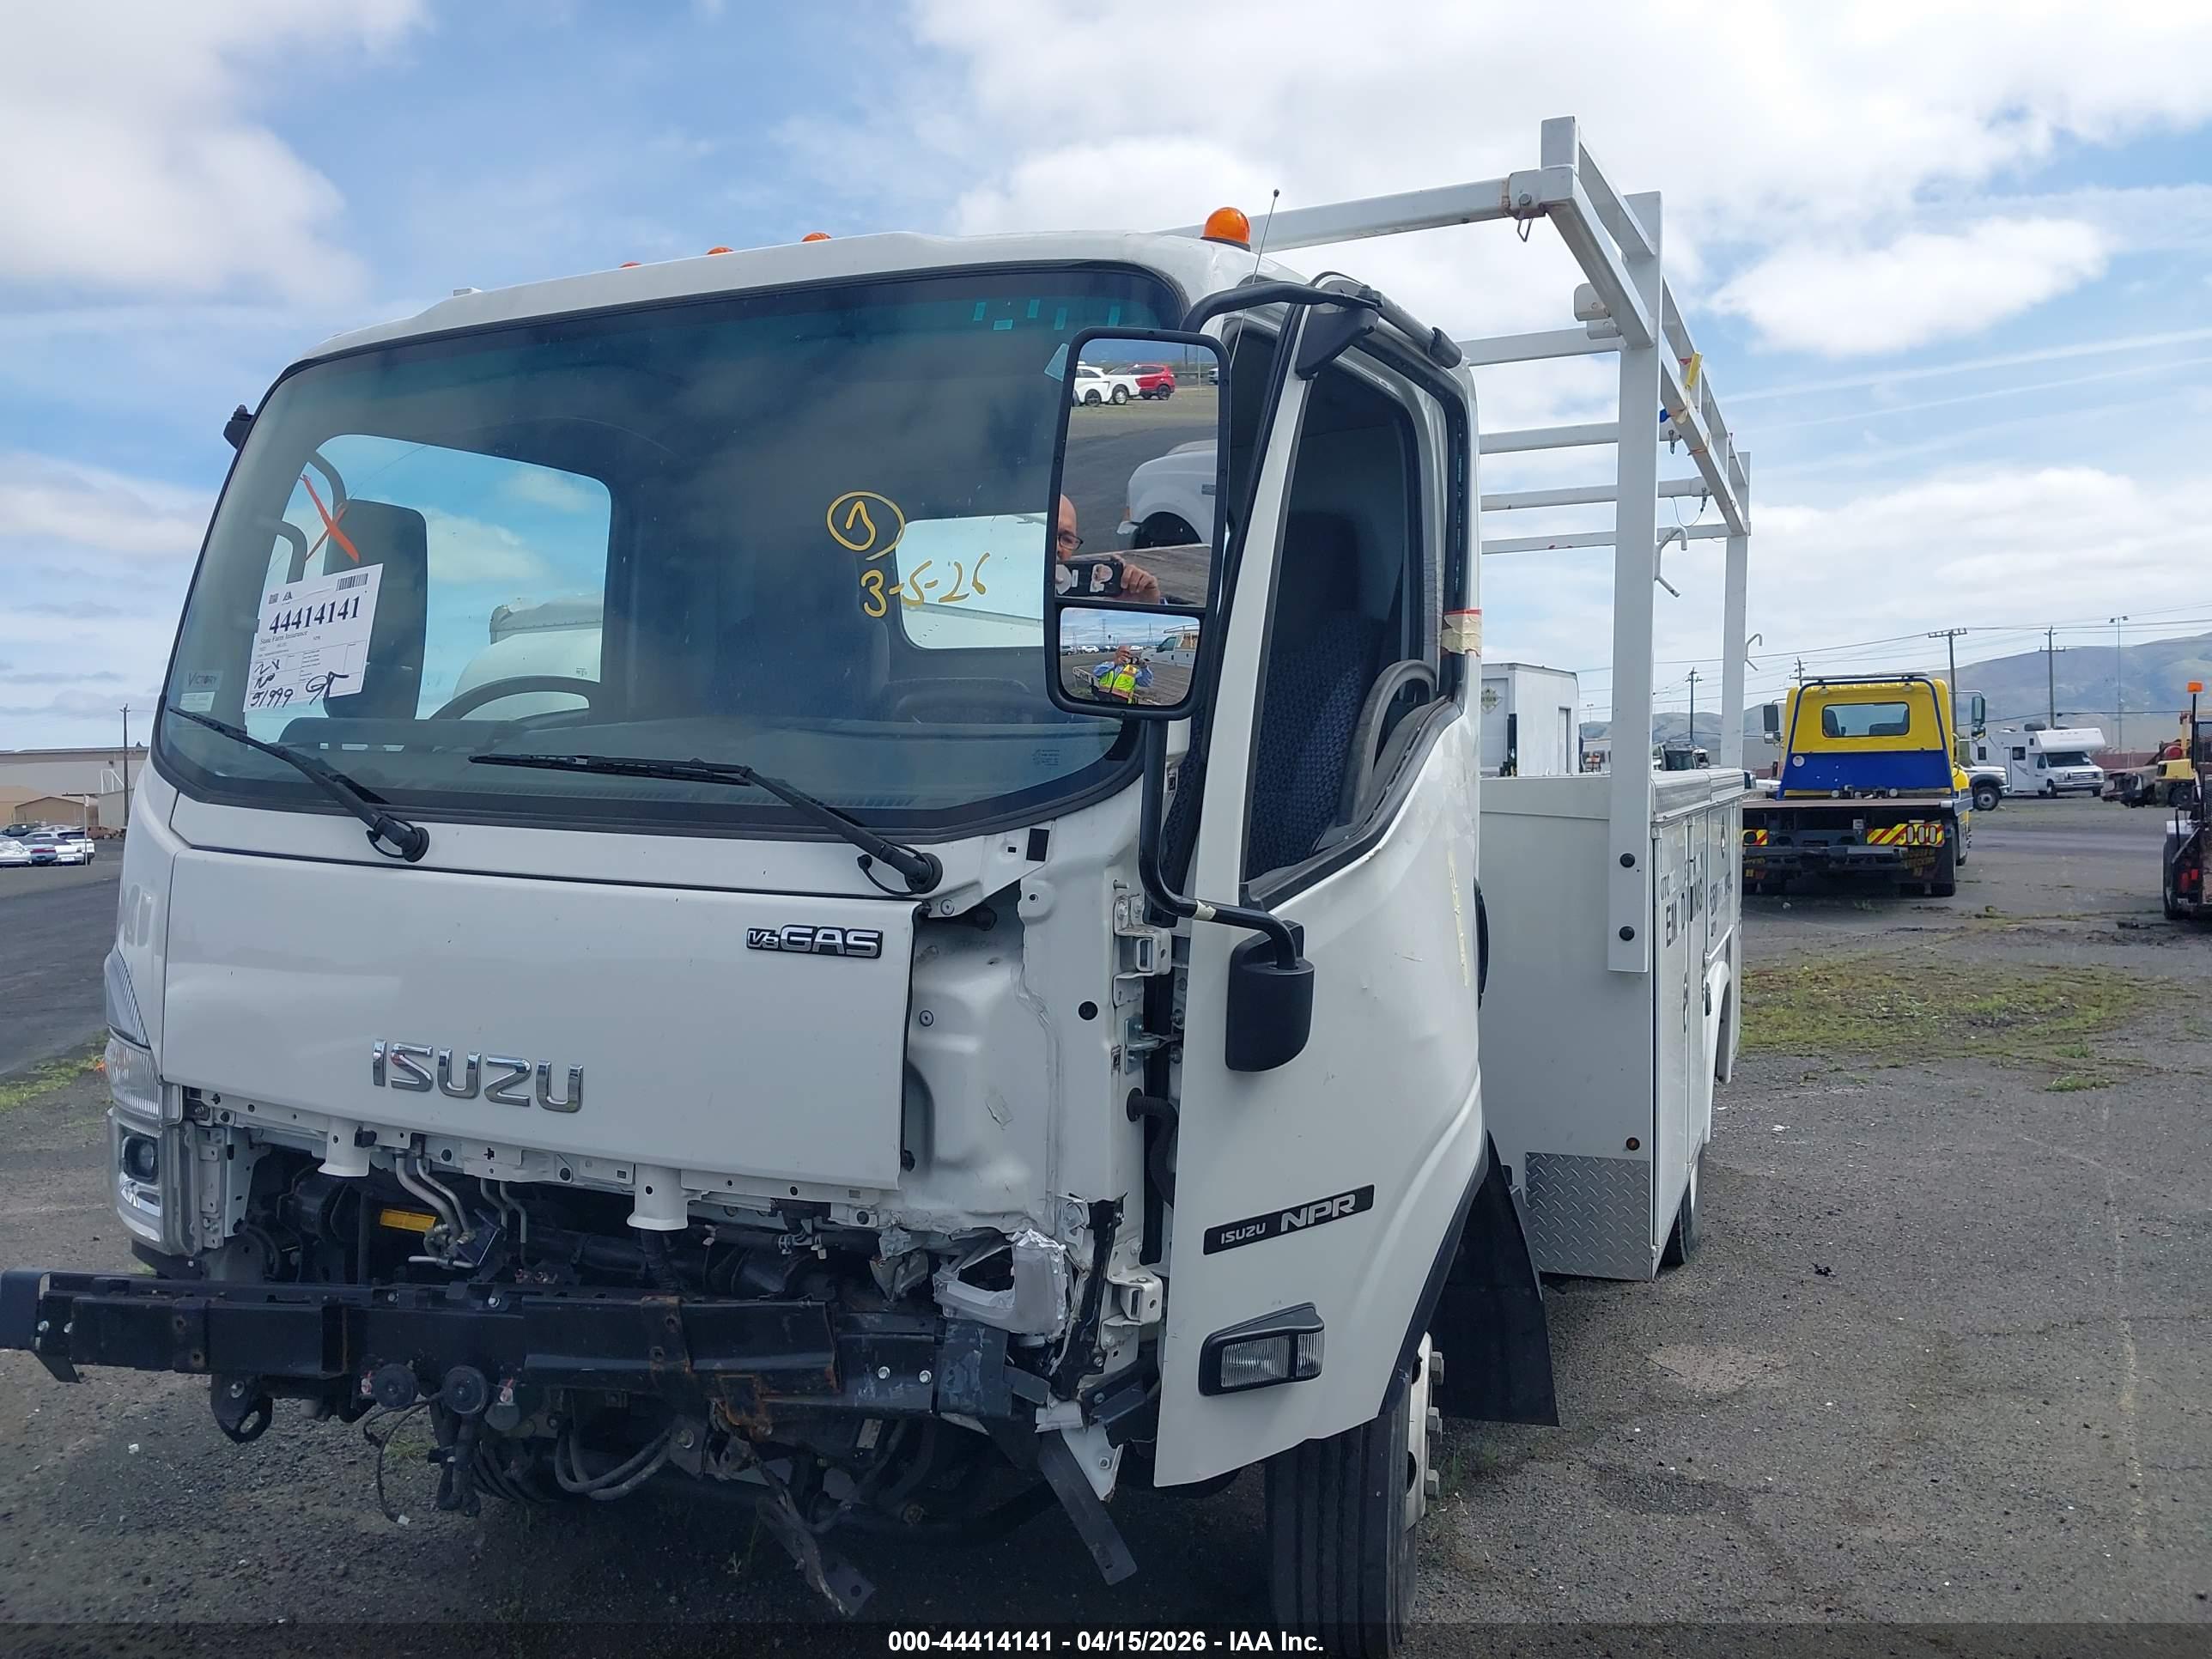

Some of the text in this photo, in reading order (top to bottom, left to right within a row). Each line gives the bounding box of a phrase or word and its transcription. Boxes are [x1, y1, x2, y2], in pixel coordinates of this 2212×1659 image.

[860, 552, 990, 618] 3-5-26
[270, 596, 360, 635] 44414141
[780, 925, 879, 958] GAS
[372, 1038, 585, 1114] ISUZU
[1220, 1193, 1357, 1245] ISUZU NPR
